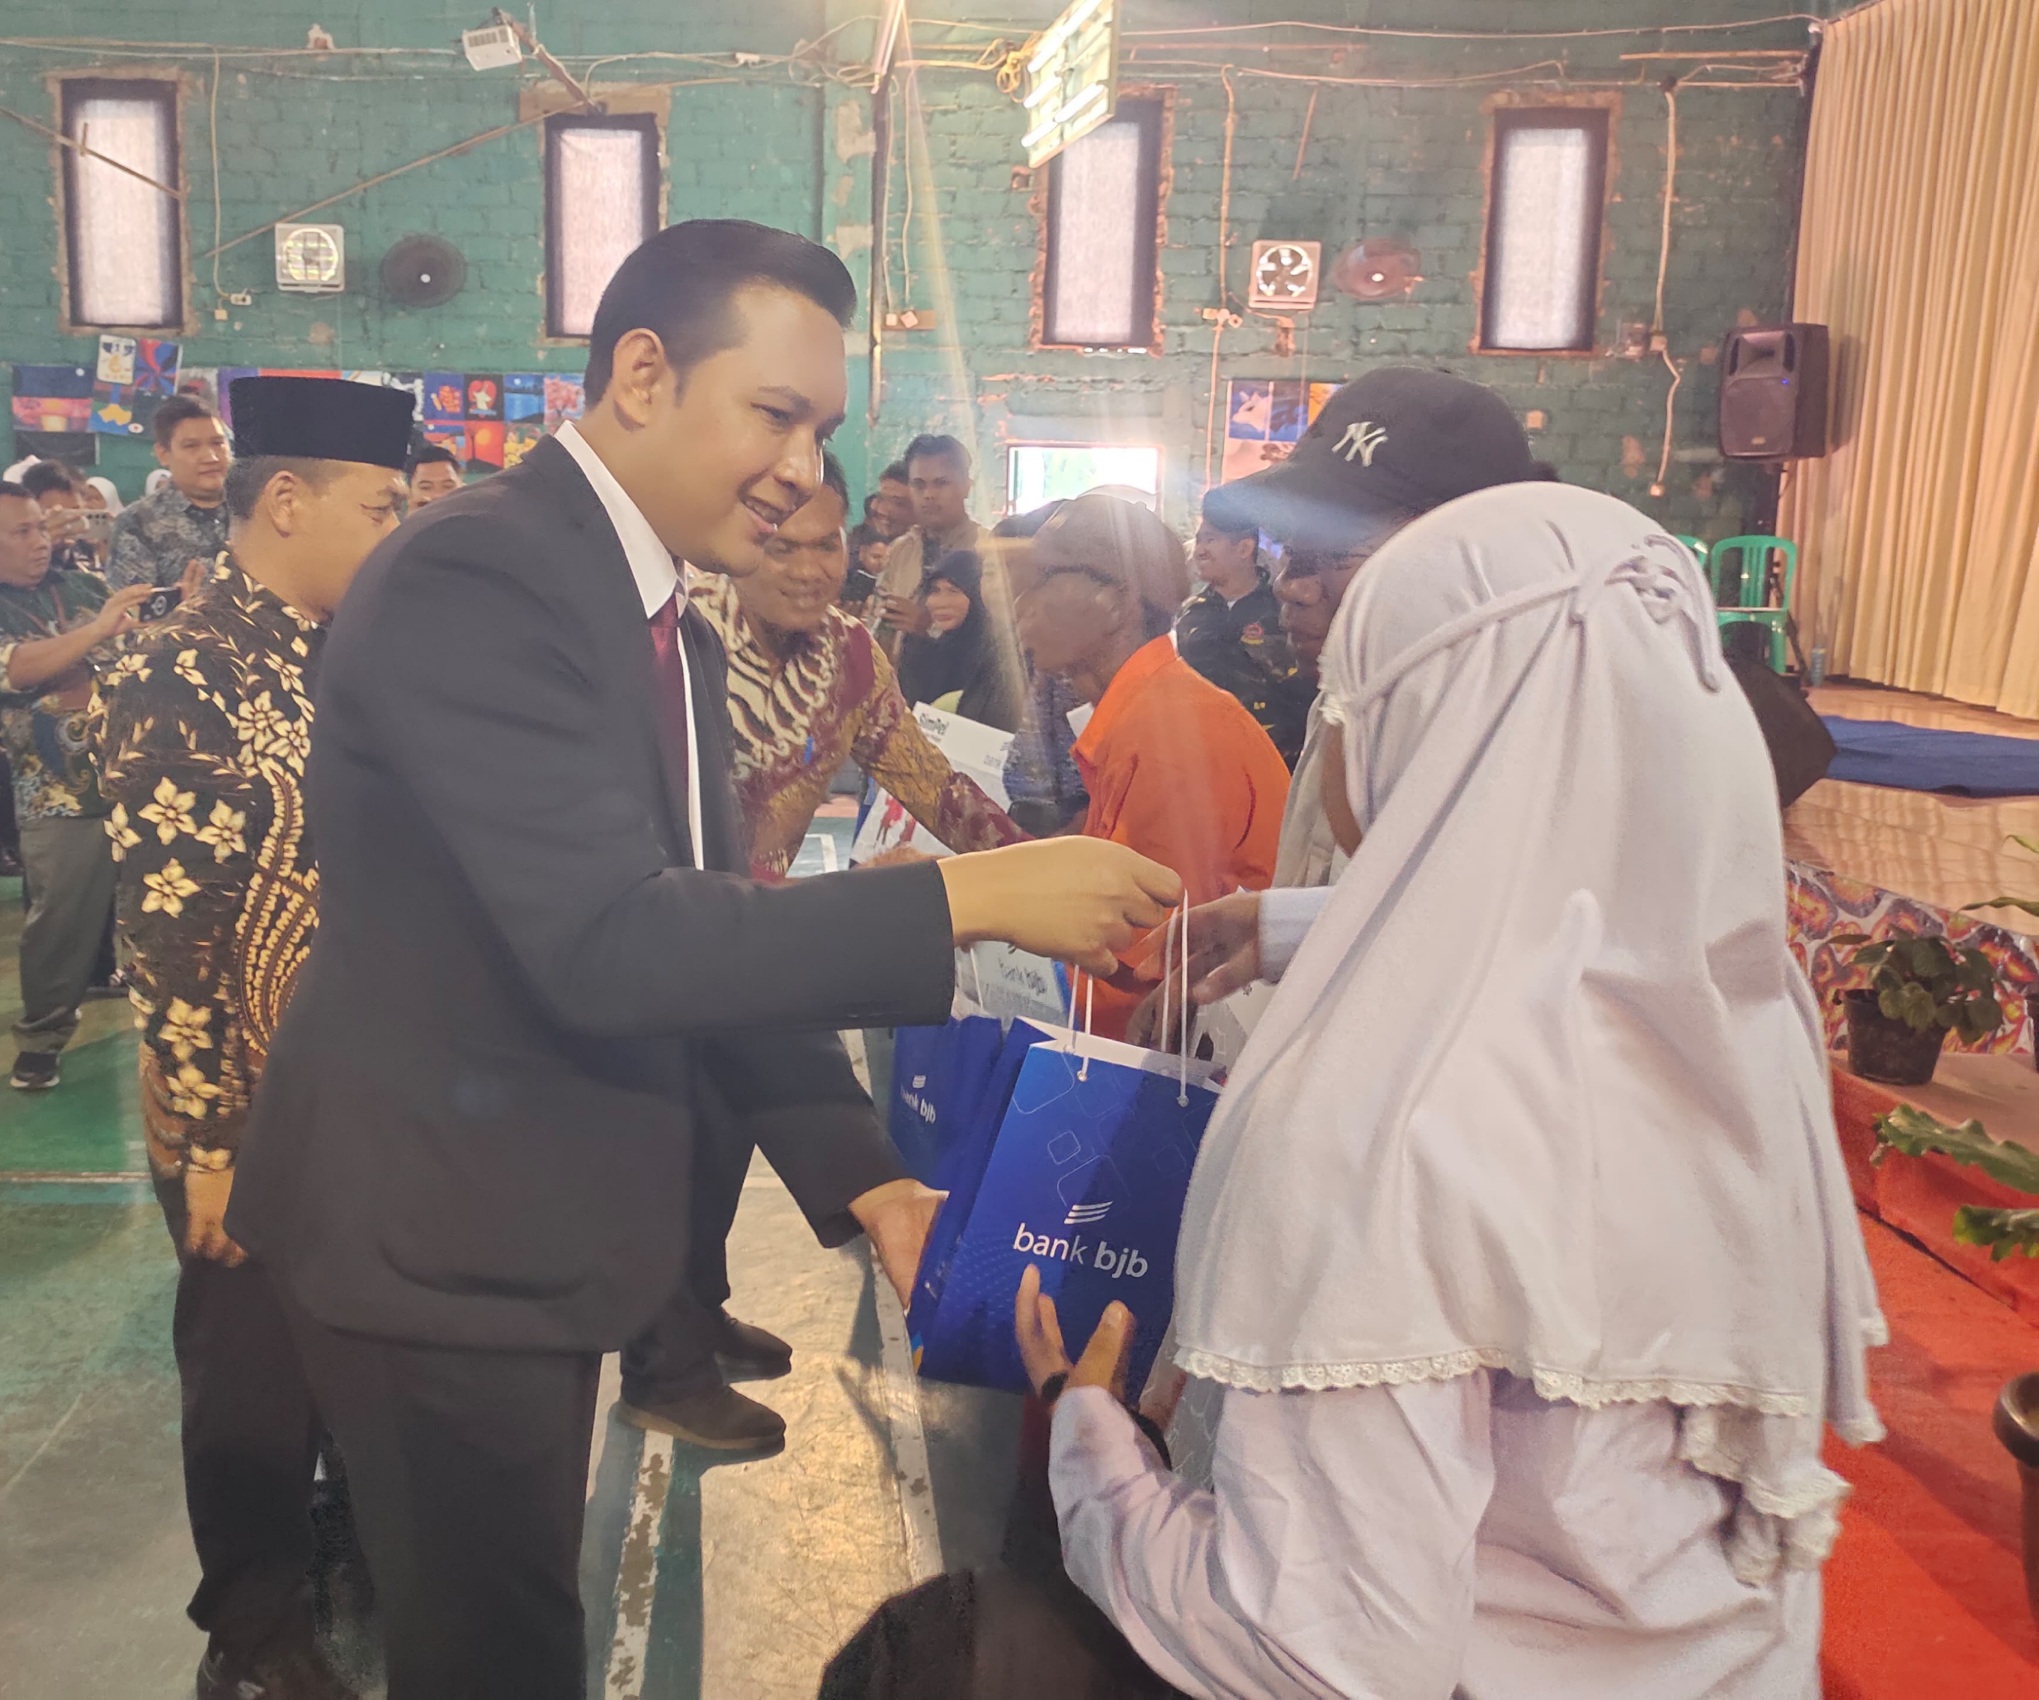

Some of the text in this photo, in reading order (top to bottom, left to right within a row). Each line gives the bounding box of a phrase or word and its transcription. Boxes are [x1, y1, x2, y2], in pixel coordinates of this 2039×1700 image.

[1331, 421, 1388, 467] NY
[920, 1098, 936, 1124] bjb
[1013, 1222, 1148, 1279] bank bjb
